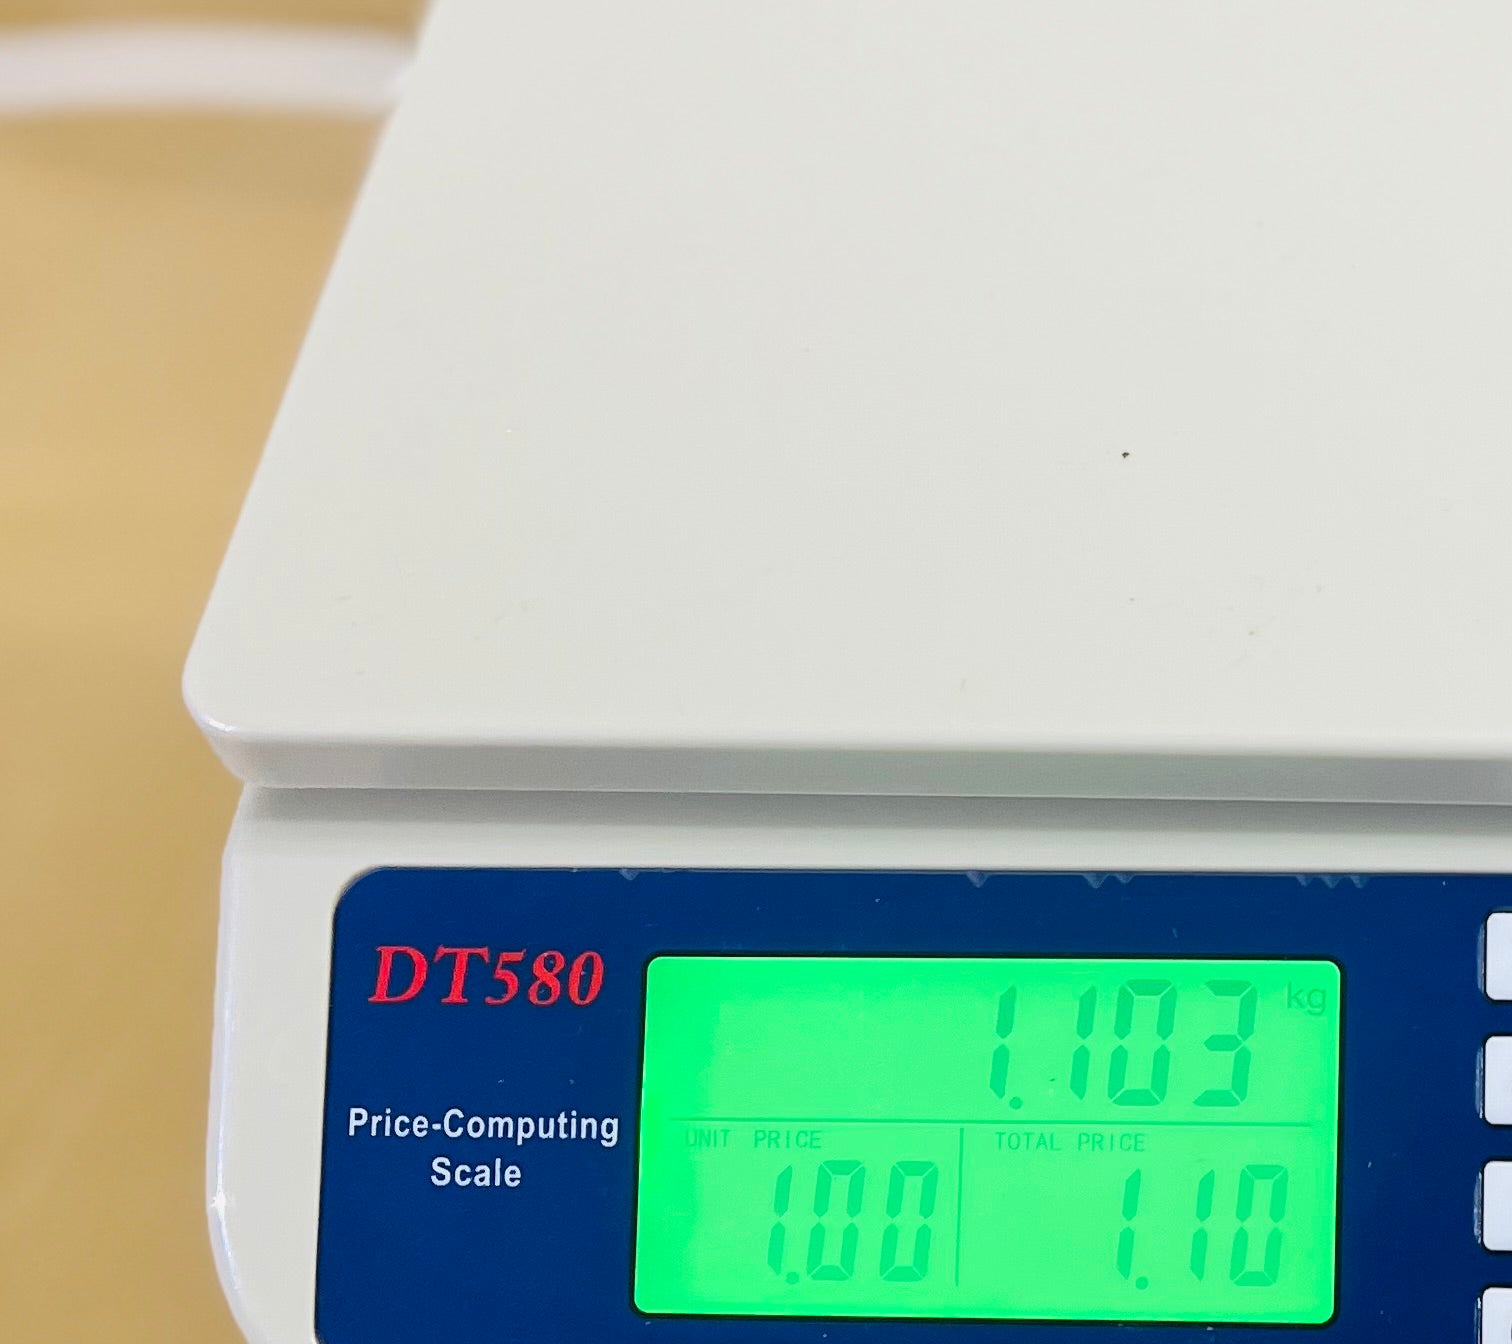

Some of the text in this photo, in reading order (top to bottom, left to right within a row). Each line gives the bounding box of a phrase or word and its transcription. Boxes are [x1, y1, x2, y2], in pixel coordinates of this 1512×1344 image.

[367, 944, 606, 1006] DT580
[989, 978, 1327, 1110] 1.103 kg
[348, 1106, 620, 1148] Price-Computing
[684, 1128, 822, 1149] UNIT PRICE
[995, 1132, 1146, 1152] TOTAL PRICE
[430, 1156, 522, 1187] Scale
[767, 1159, 939, 1286] 1.00
[1116, 1164, 1289, 1290] 1.10
